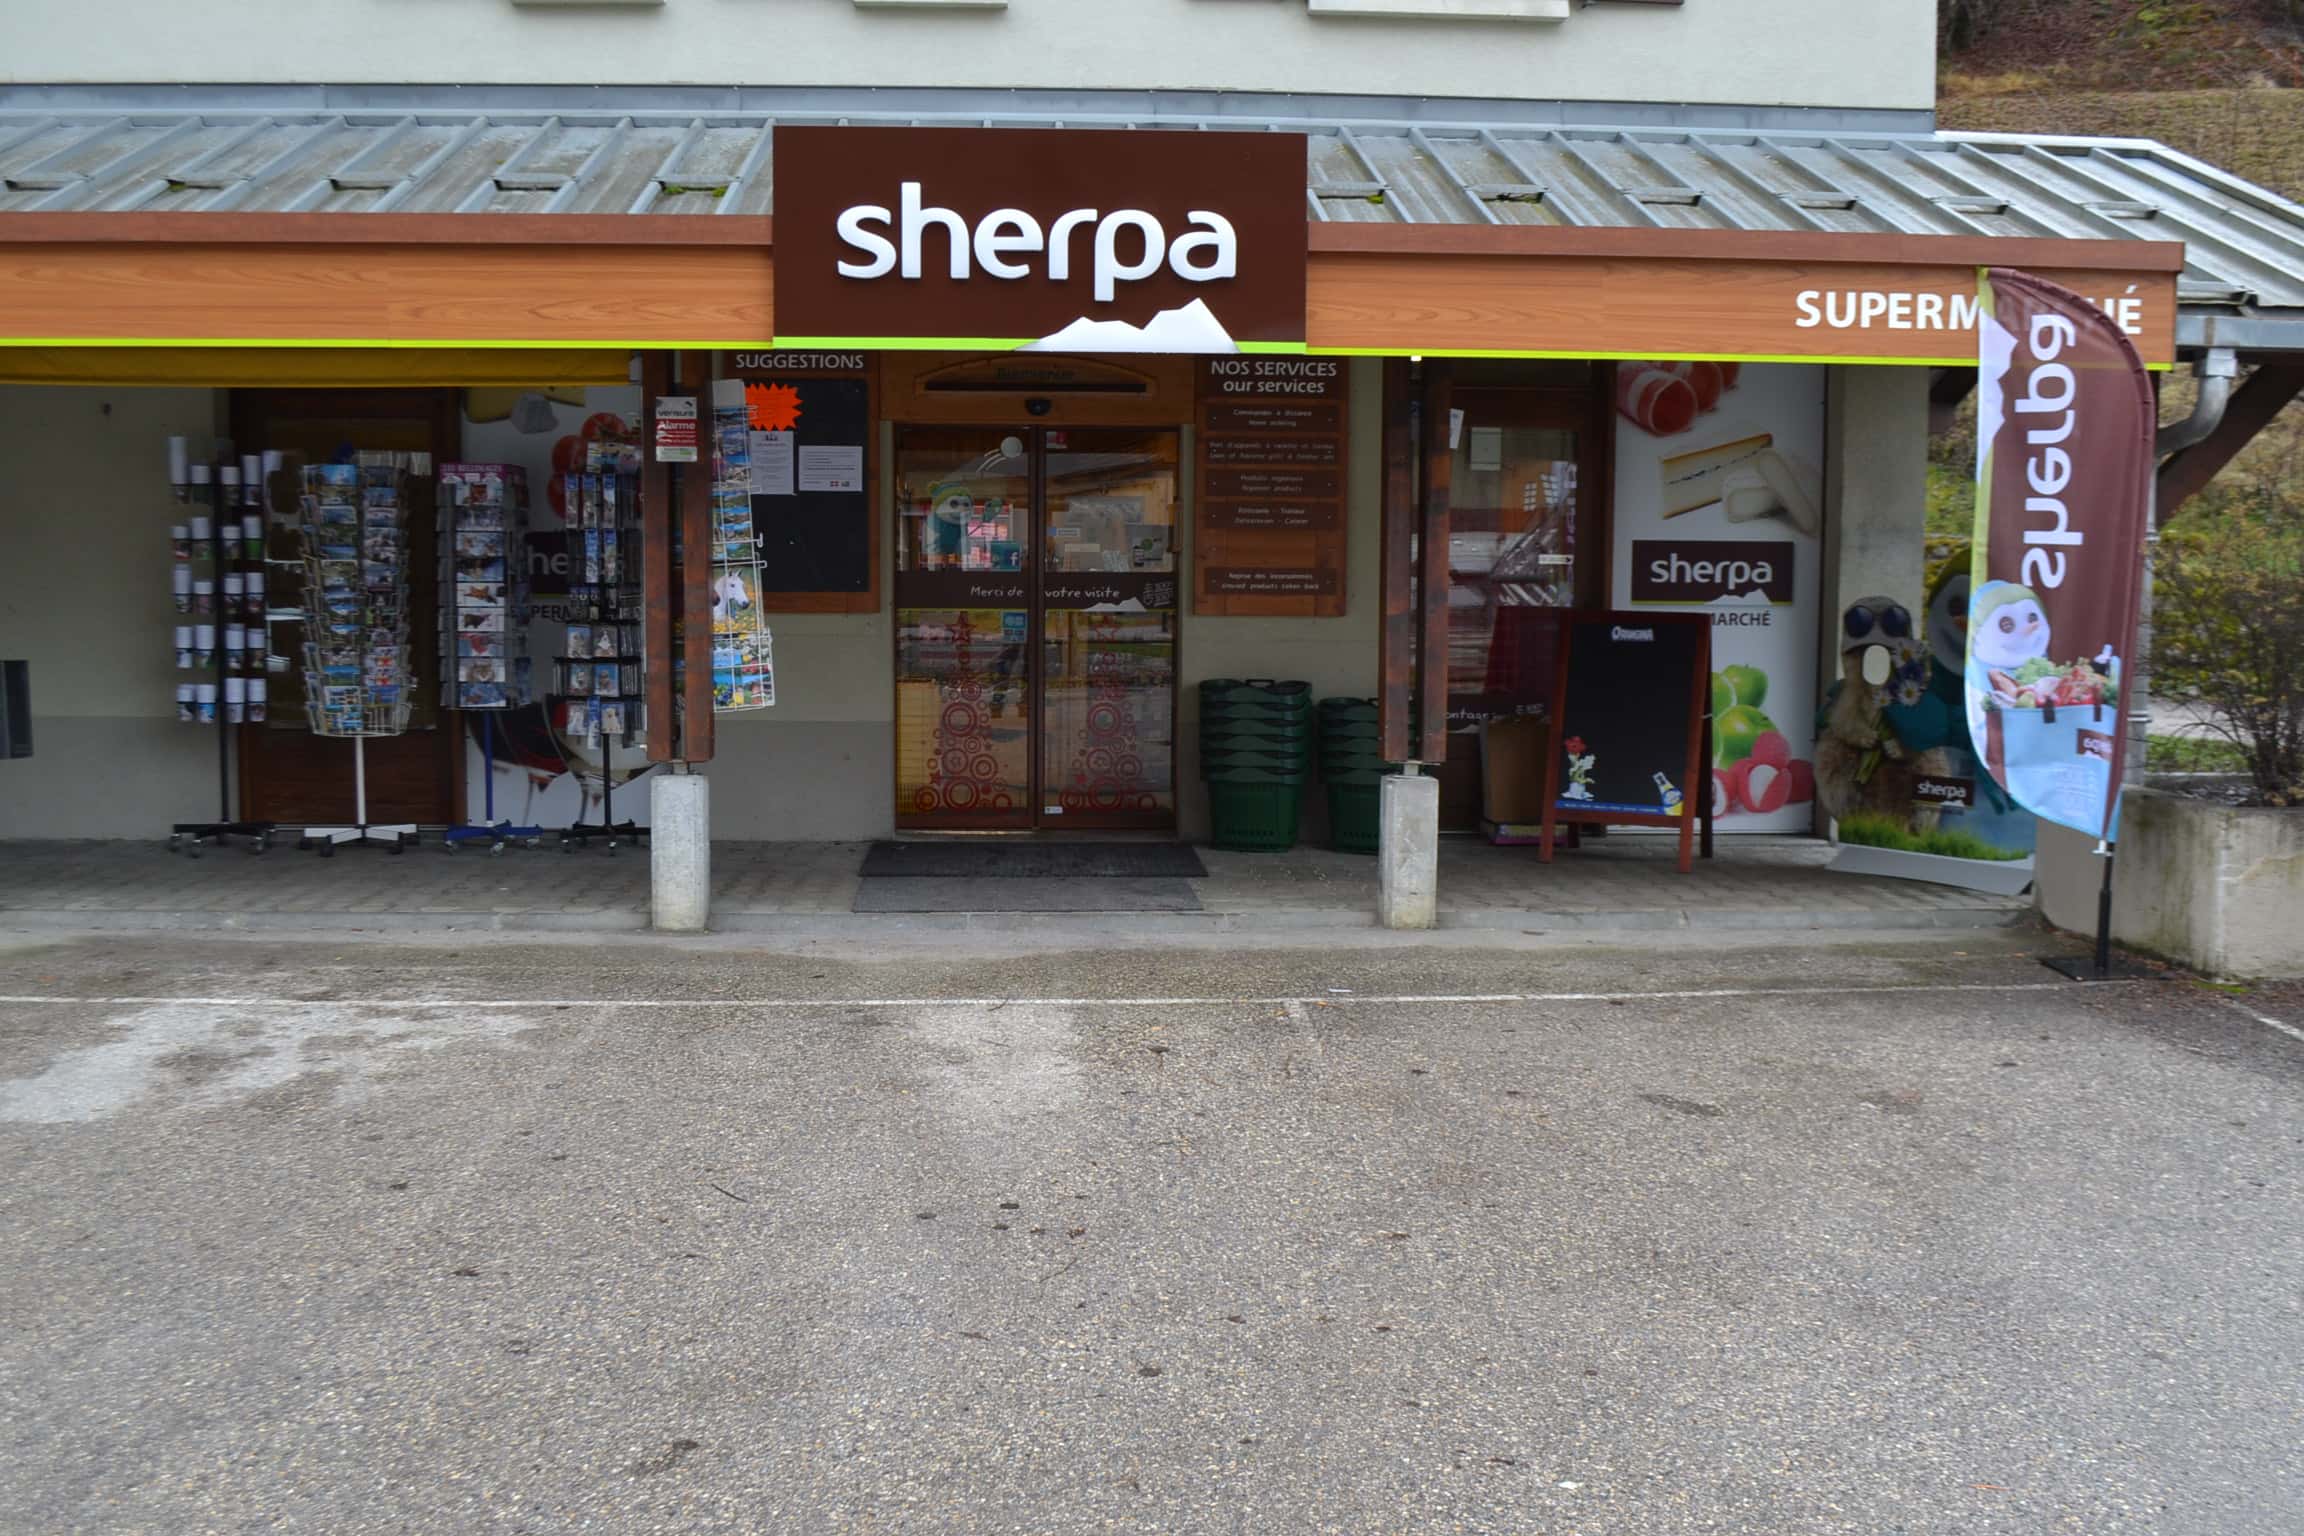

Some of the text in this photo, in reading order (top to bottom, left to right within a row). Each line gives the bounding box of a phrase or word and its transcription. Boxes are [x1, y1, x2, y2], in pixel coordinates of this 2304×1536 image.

[836, 182, 1237, 301] sherpa
[1795, 285, 2143, 335] SUPERMÉ
[735, 354, 865, 369] SUGGESTIONS
[1211, 360, 1337, 377] NOS SERVICES
[1223, 379, 1326, 393] our services
[657, 420, 696, 430] Alarme
[1649, 553, 1774, 590] sherpa
[970, 585, 1121, 599] Merci de votre visite
[1917, 779, 1968, 800] sherpa
